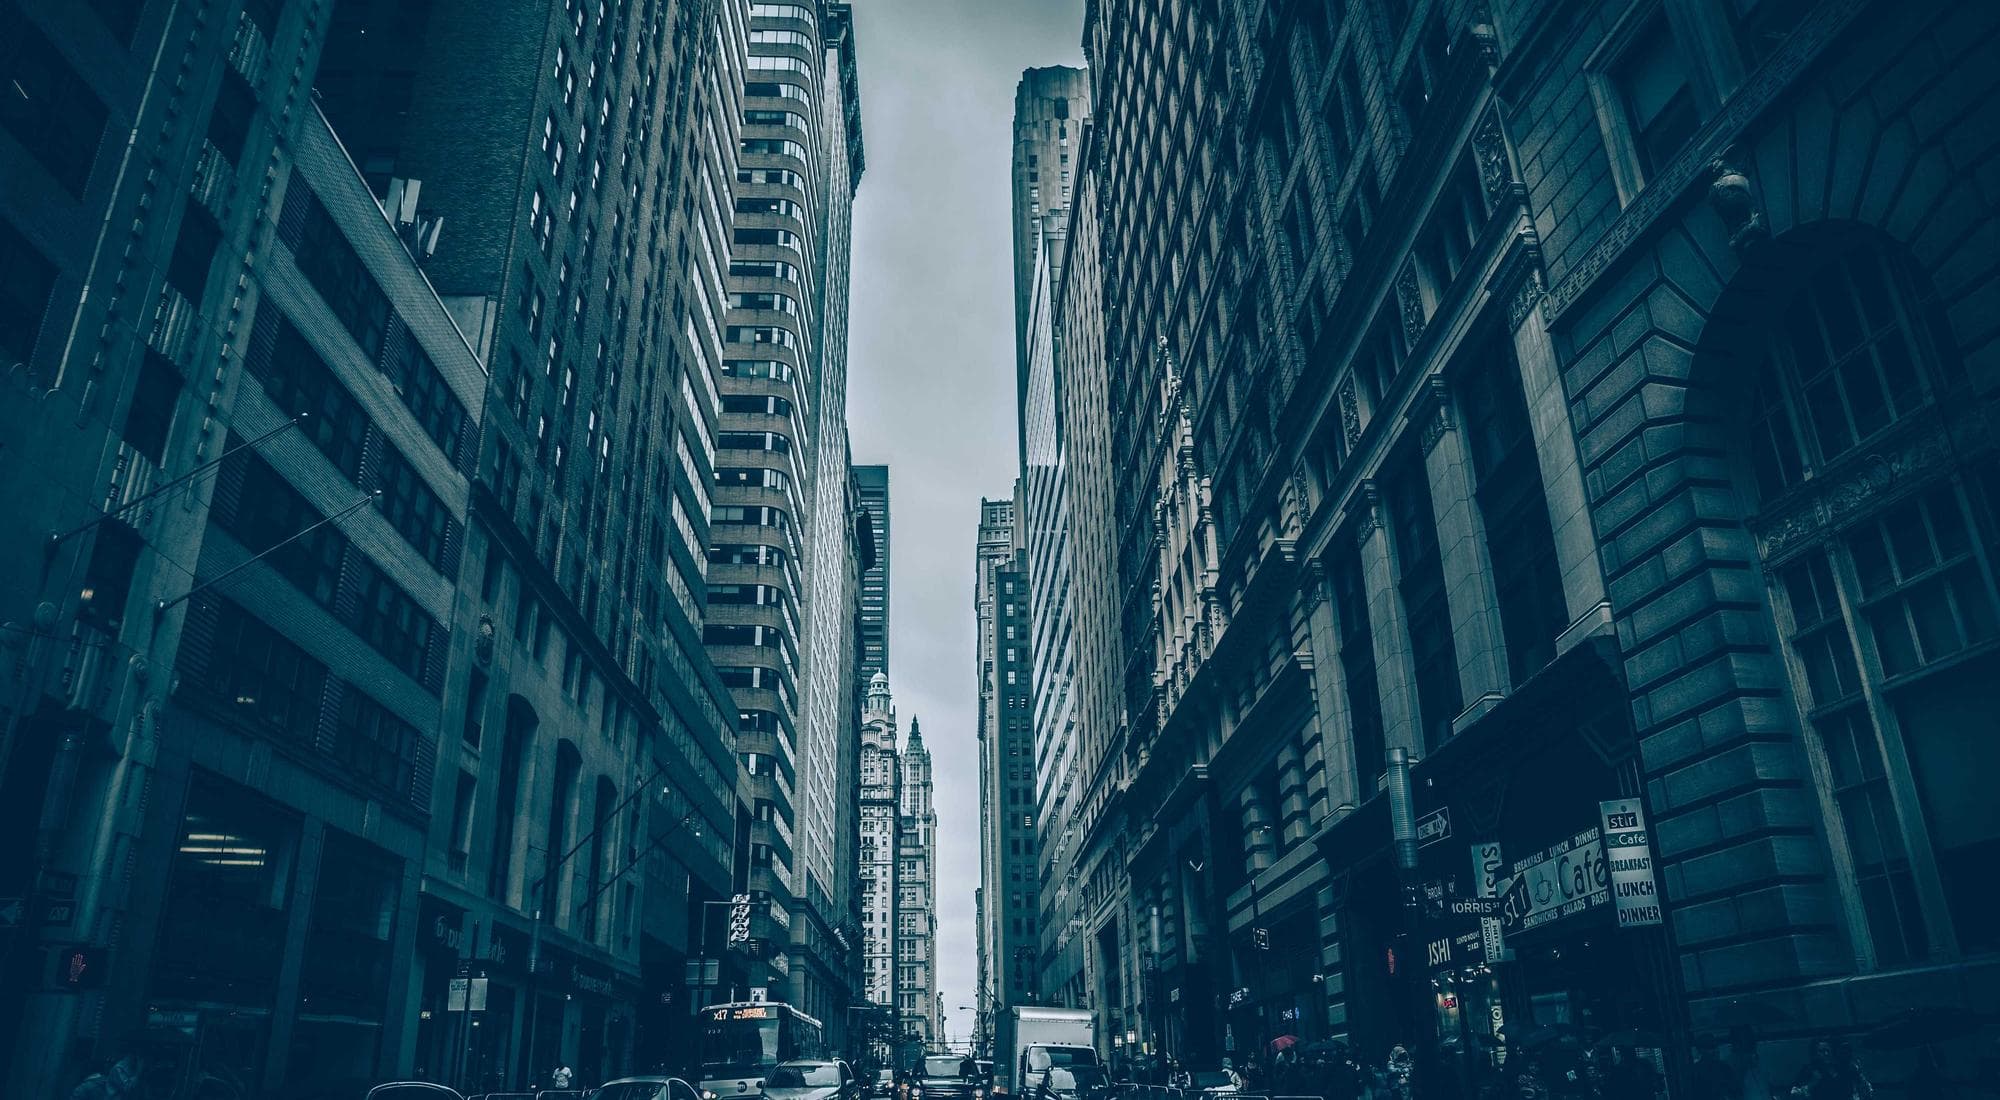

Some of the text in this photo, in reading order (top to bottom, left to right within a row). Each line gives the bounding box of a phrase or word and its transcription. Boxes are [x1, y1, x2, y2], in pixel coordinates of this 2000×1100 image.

[1619, 833, 1646, 845] Café
[1514, 827, 1600, 874] BREAKFAST LUNCH DINNER
[1558, 847, 1608, 900] Café
[1611, 858, 1651, 873] BREAKFAST
[1617, 881, 1655, 897] LUNCH
[1524, 907, 1559, 929] SANDWICHES
[1563, 898, 1586, 916] SALADS
[1620, 906, 1661, 923] DINNER
